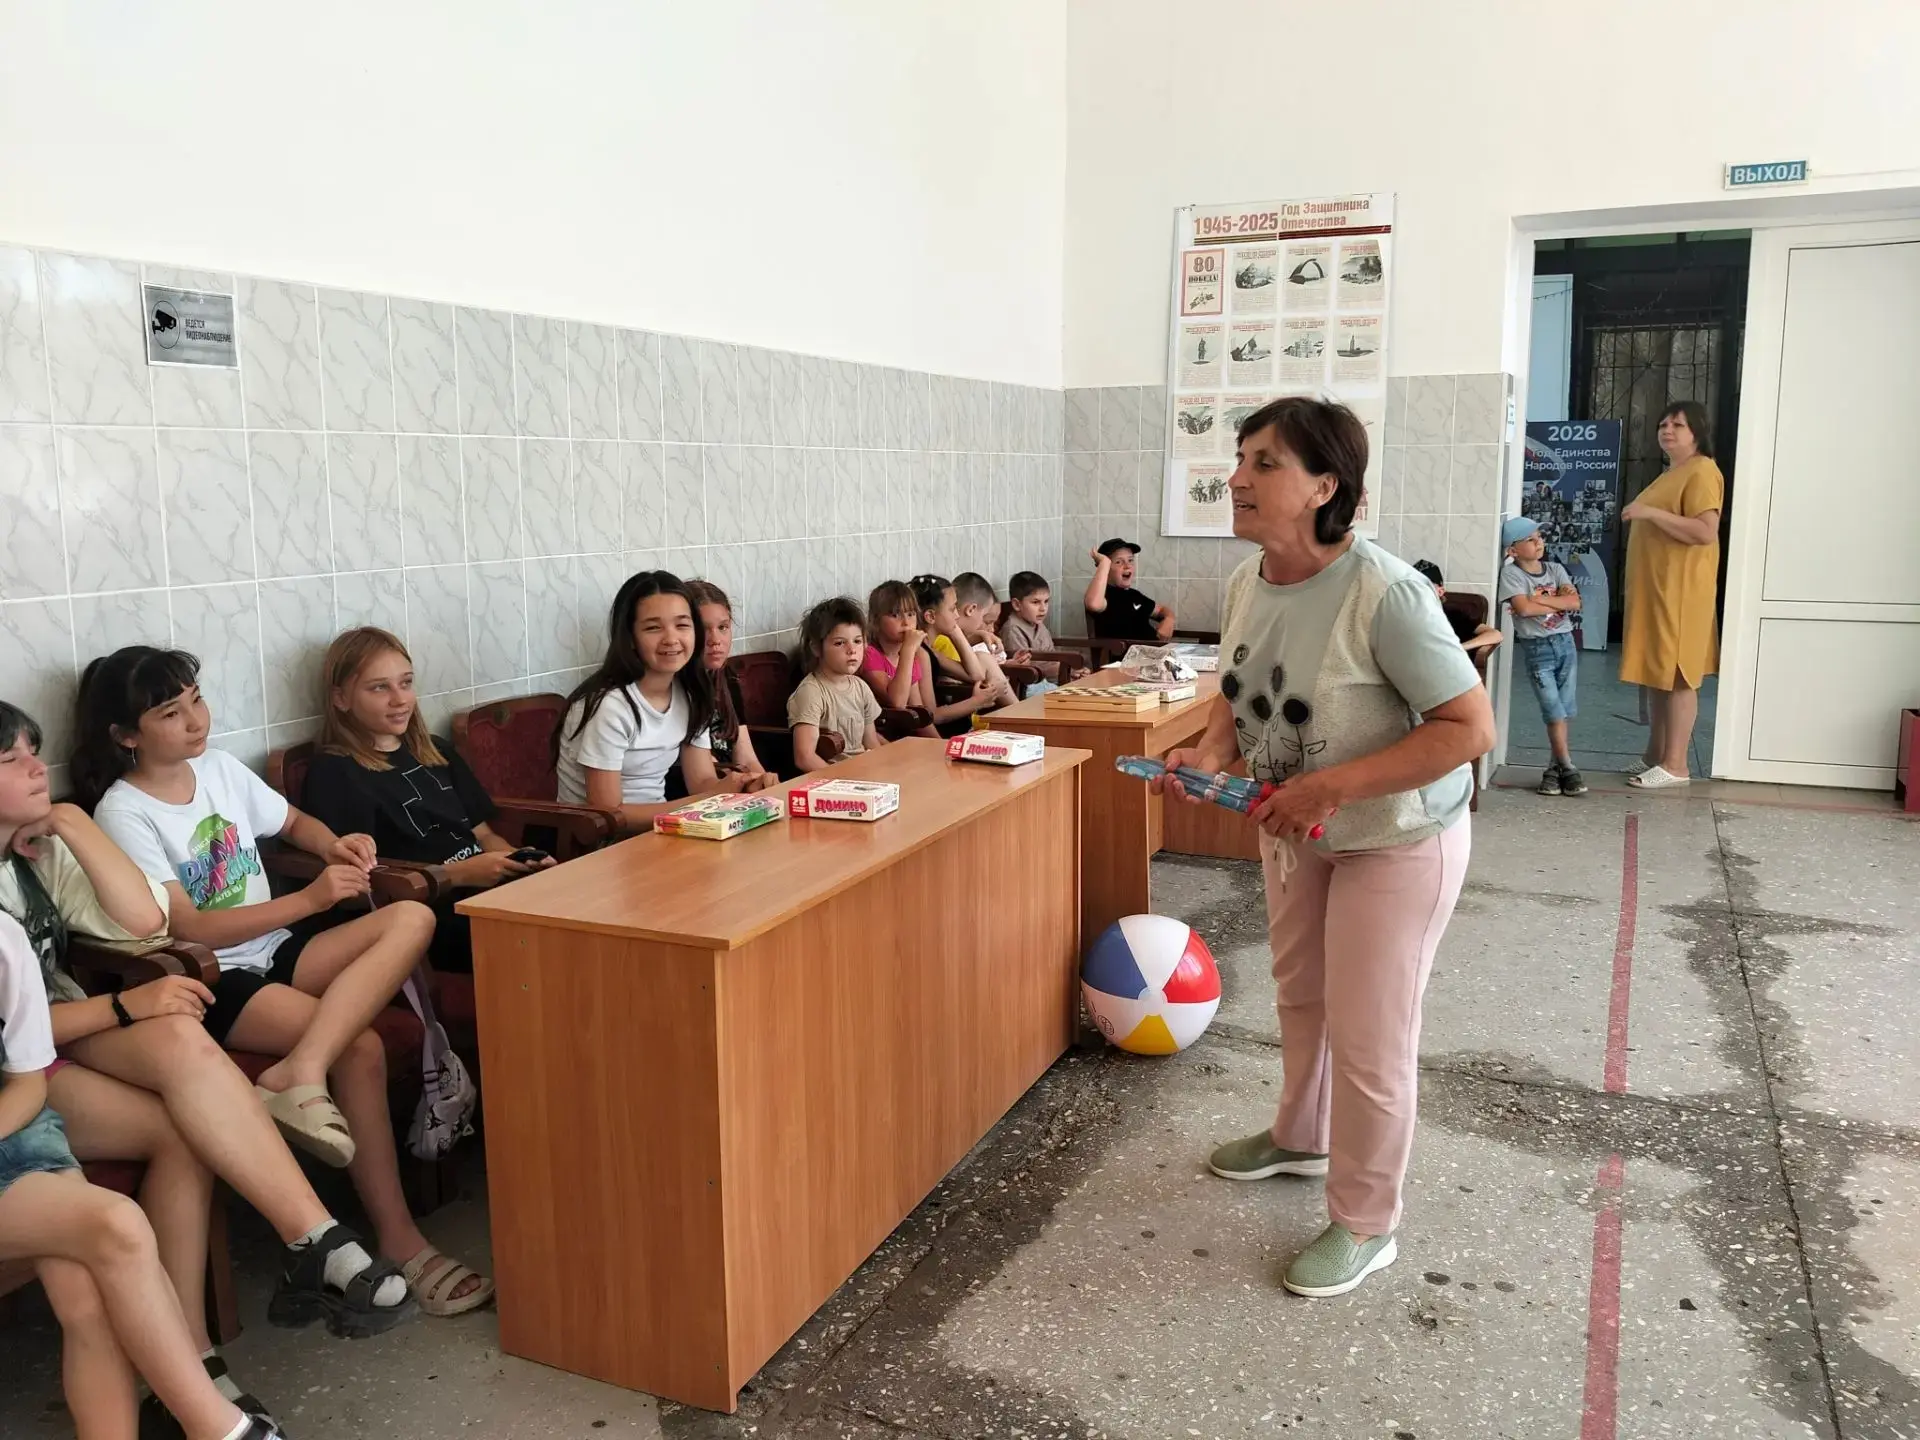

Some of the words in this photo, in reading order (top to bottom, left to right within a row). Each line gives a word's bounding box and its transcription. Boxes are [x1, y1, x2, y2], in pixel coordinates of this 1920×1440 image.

[1734, 163, 1802, 183] ВЫХОД
[1281, 204, 1300, 216] Год
[1303, 200, 1370, 214] Защитника
[1194, 212, 1278, 235] 1945-2025
[1281, 215, 1346, 230] Отечества
[1193, 256, 1215, 273] 80
[1548, 425, 1597, 441] 2026
[1532, 448, 1552, 458] Год
[1554, 448, 1611, 458] Единства
[1525, 461, 1572, 471] Народов
[1575, 461, 1617, 470] России
[966, 744, 1008, 756] ДОМИНО
[814, 798, 868, 813] ДОМИНО
